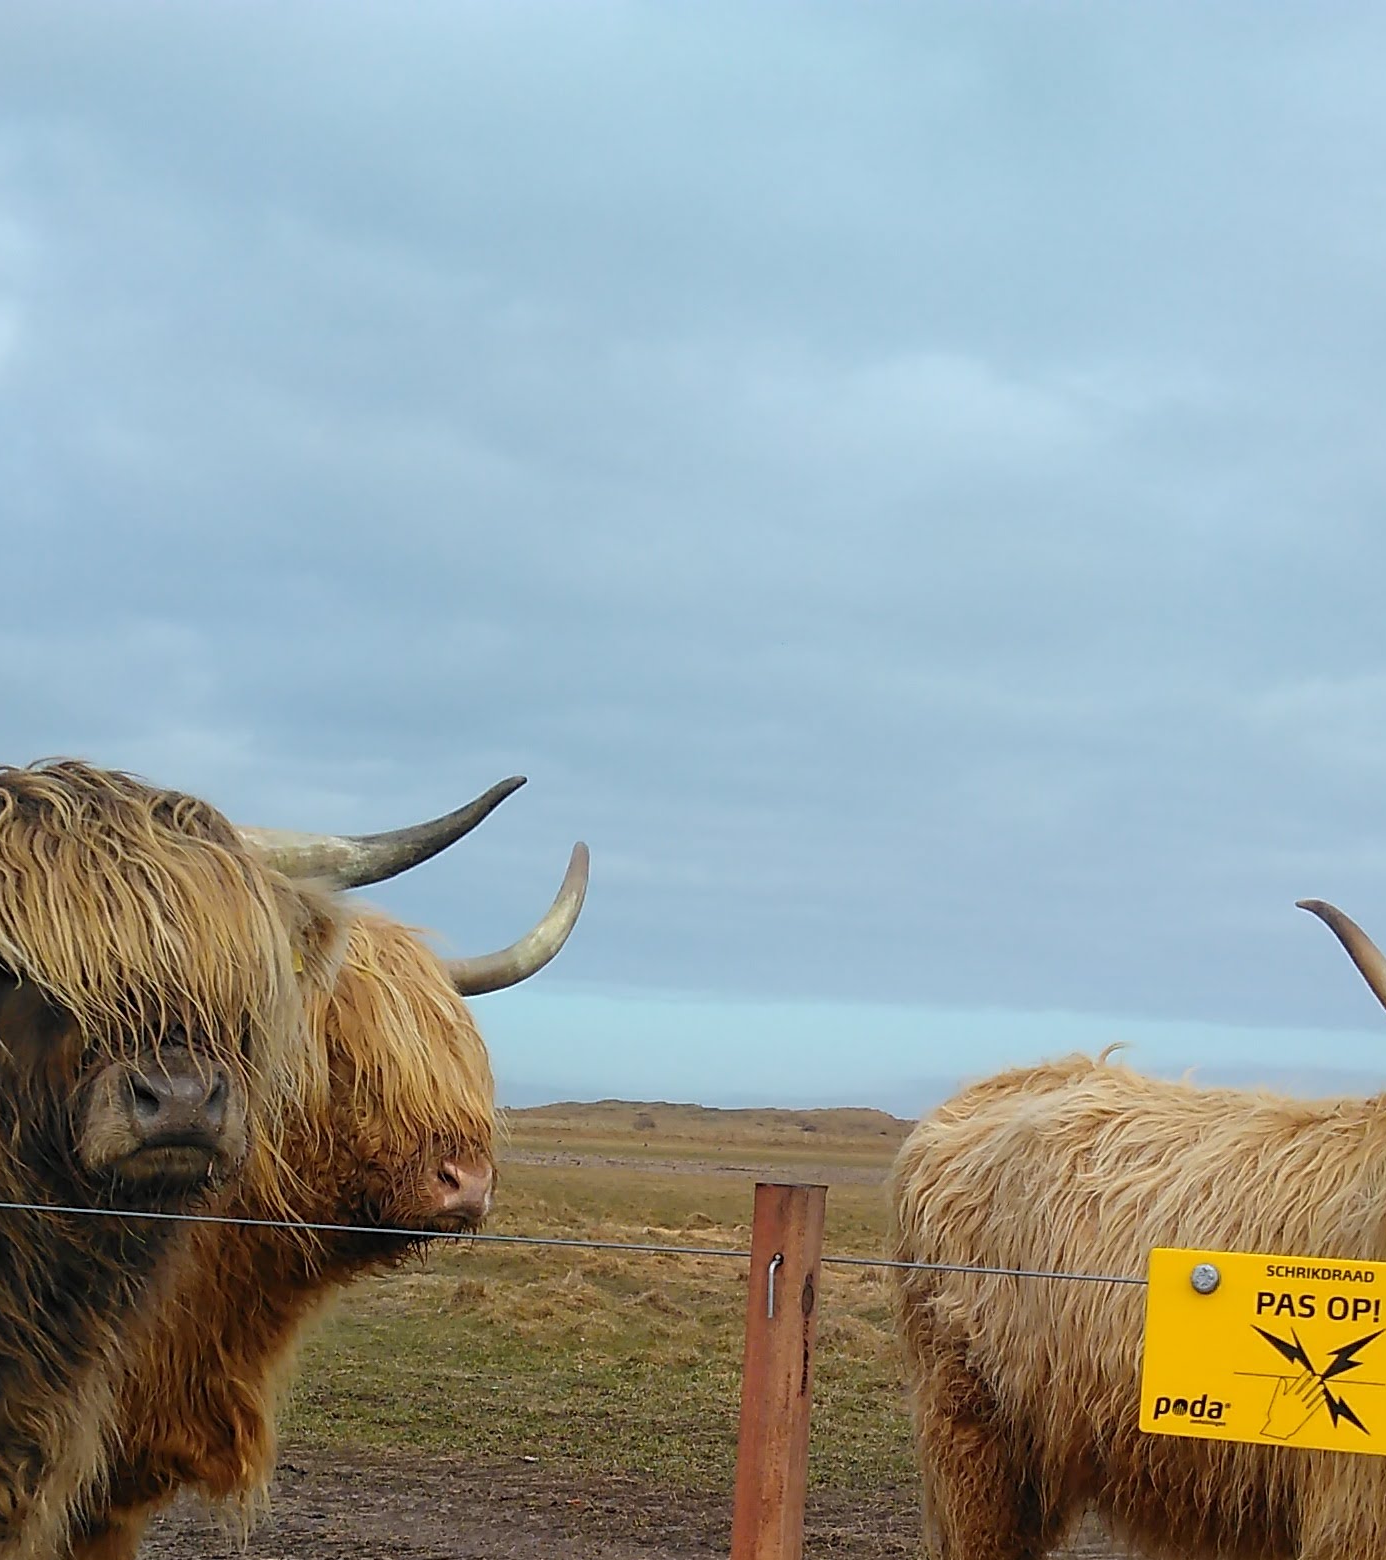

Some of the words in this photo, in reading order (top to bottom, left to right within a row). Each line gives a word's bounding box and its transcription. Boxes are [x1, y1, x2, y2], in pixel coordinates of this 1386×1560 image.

[1266, 1265, 1375, 1283] SCHRIKDRAAD
[1256, 1292, 1316, 1318] PAS
[1327, 1297, 1380, 1323] OP!
